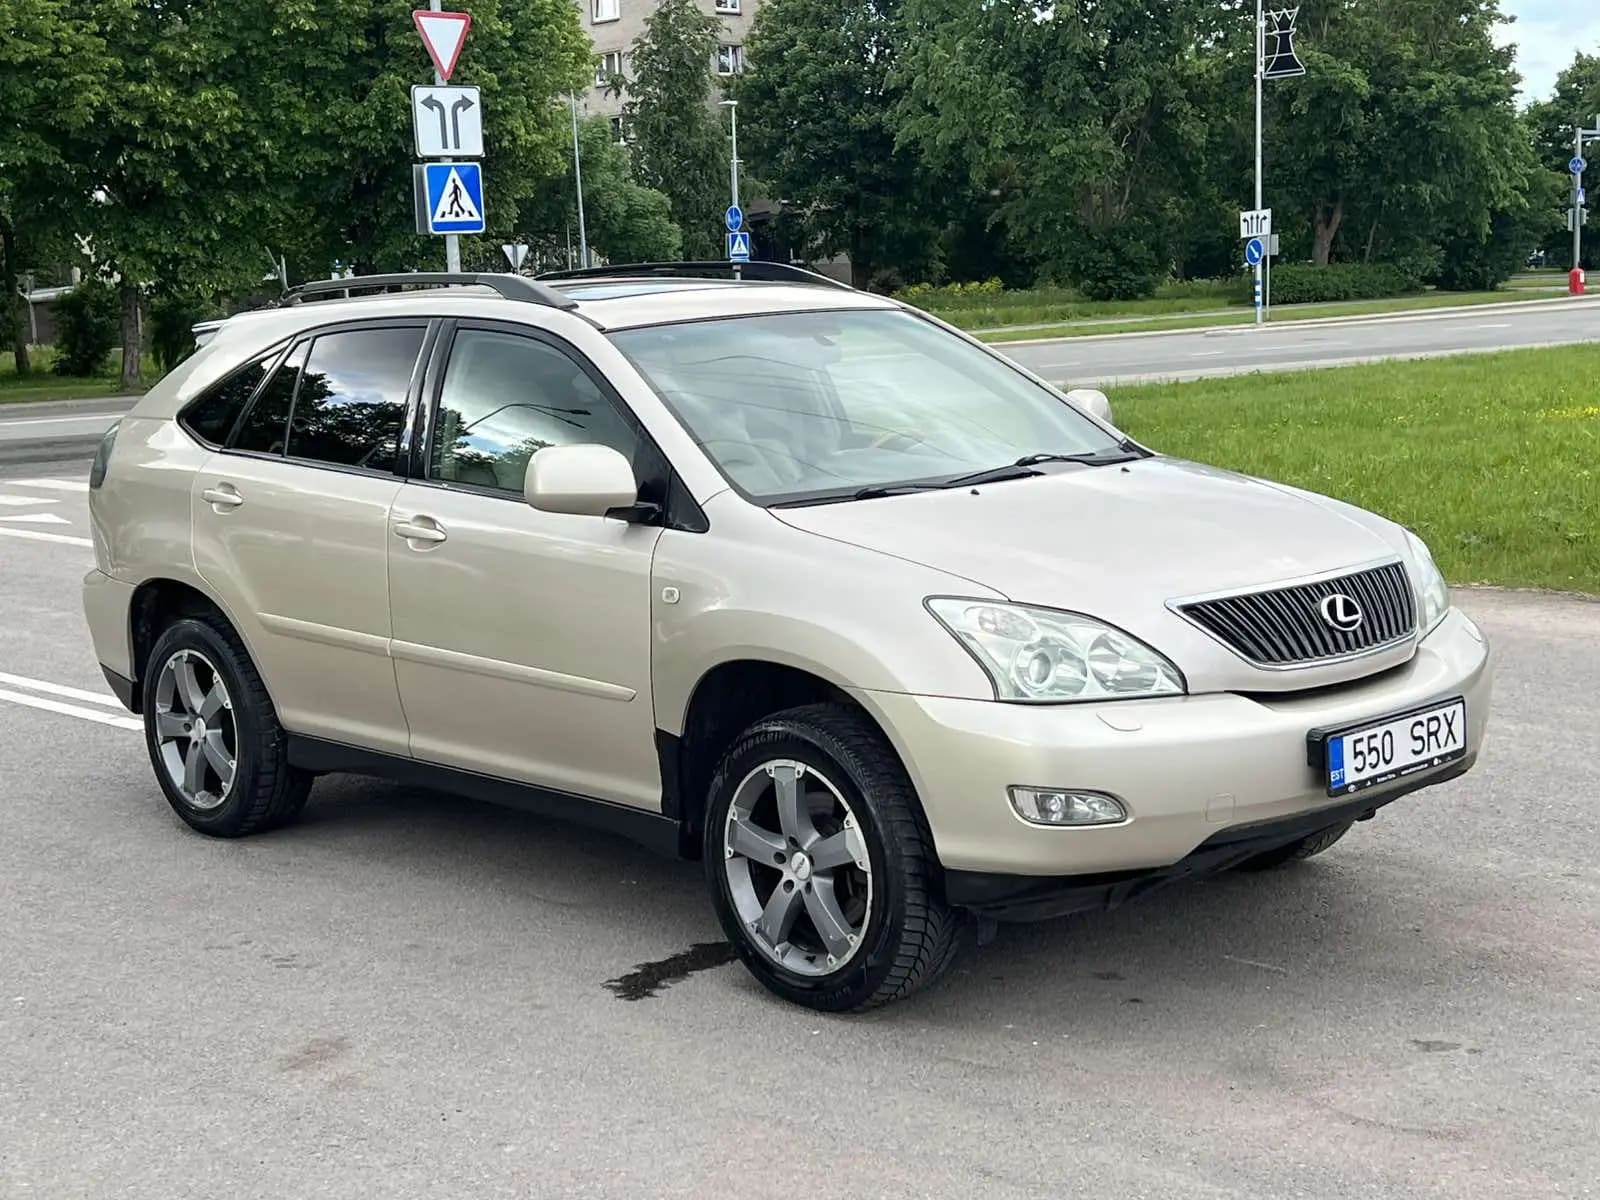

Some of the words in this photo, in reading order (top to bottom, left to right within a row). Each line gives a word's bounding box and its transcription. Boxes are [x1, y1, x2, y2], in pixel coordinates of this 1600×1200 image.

[1353, 730, 1394, 773] 550
[1410, 709, 1457, 756] SRX
[1330, 768, 1344, 781] EST
